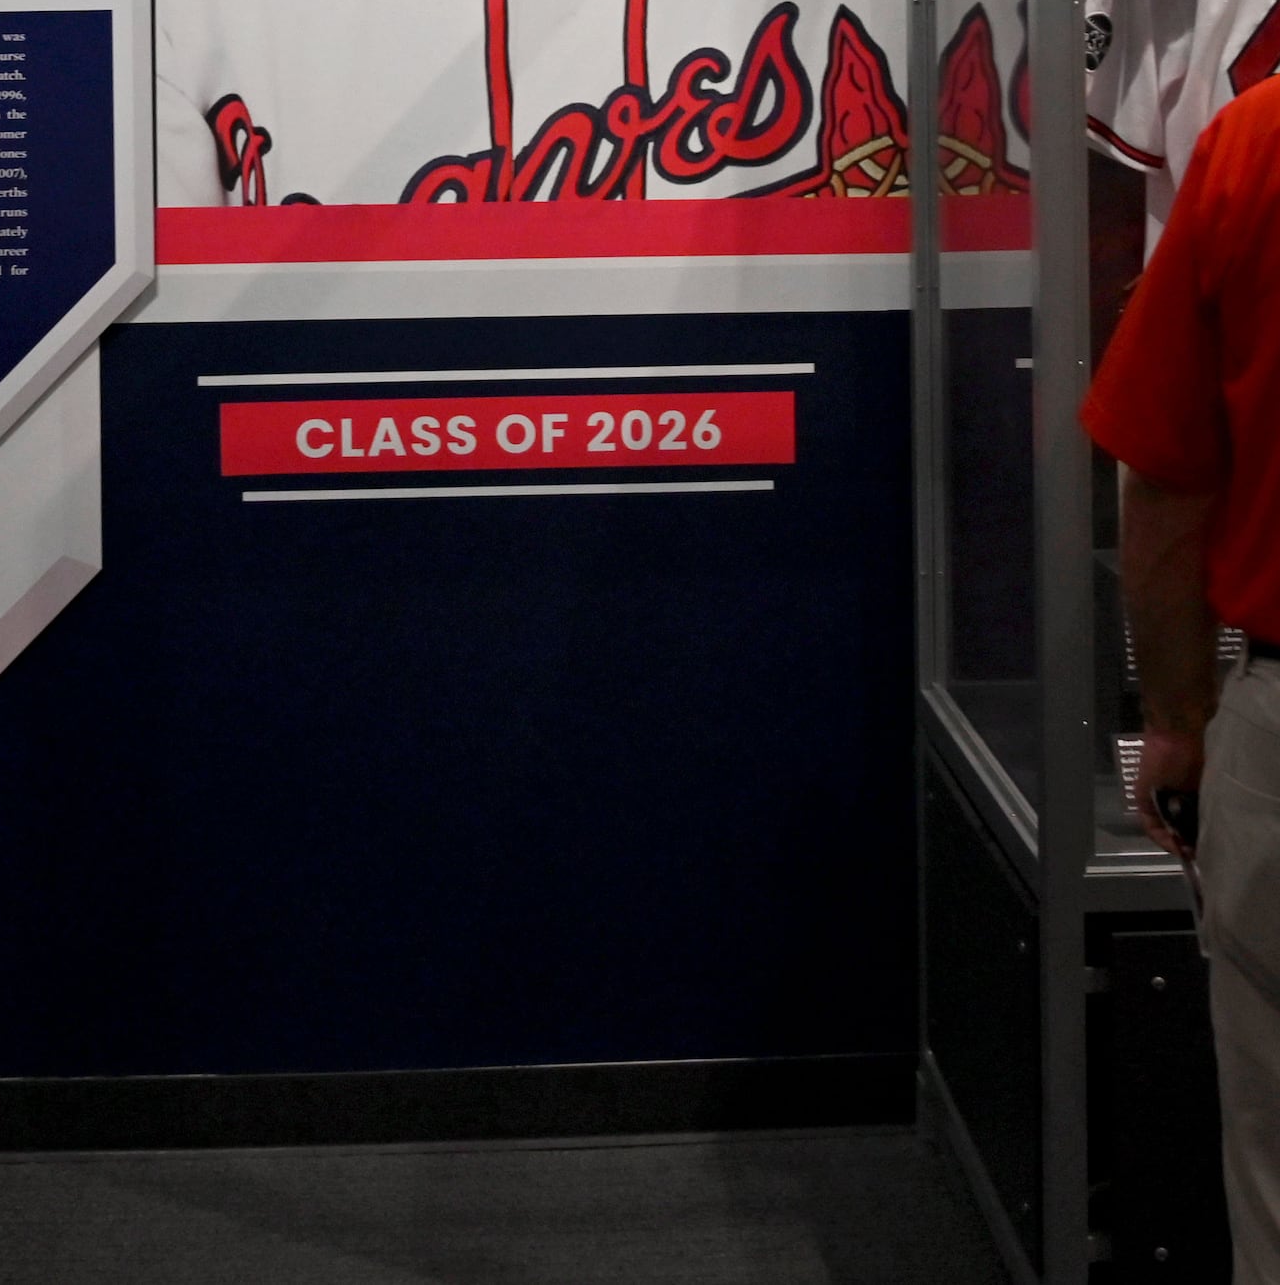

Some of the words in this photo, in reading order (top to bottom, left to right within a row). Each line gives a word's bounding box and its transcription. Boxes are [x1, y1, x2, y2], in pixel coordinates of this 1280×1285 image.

[2, 33, 25, 41] was
[6, 108, 26, 119] the
[0, 209, 28, 217] runs
[10, 264, 29, 275] for
[295, 416, 476, 459] CLASS
[495, 413, 568, 453] OF
[586, 409, 722, 452] 2026
